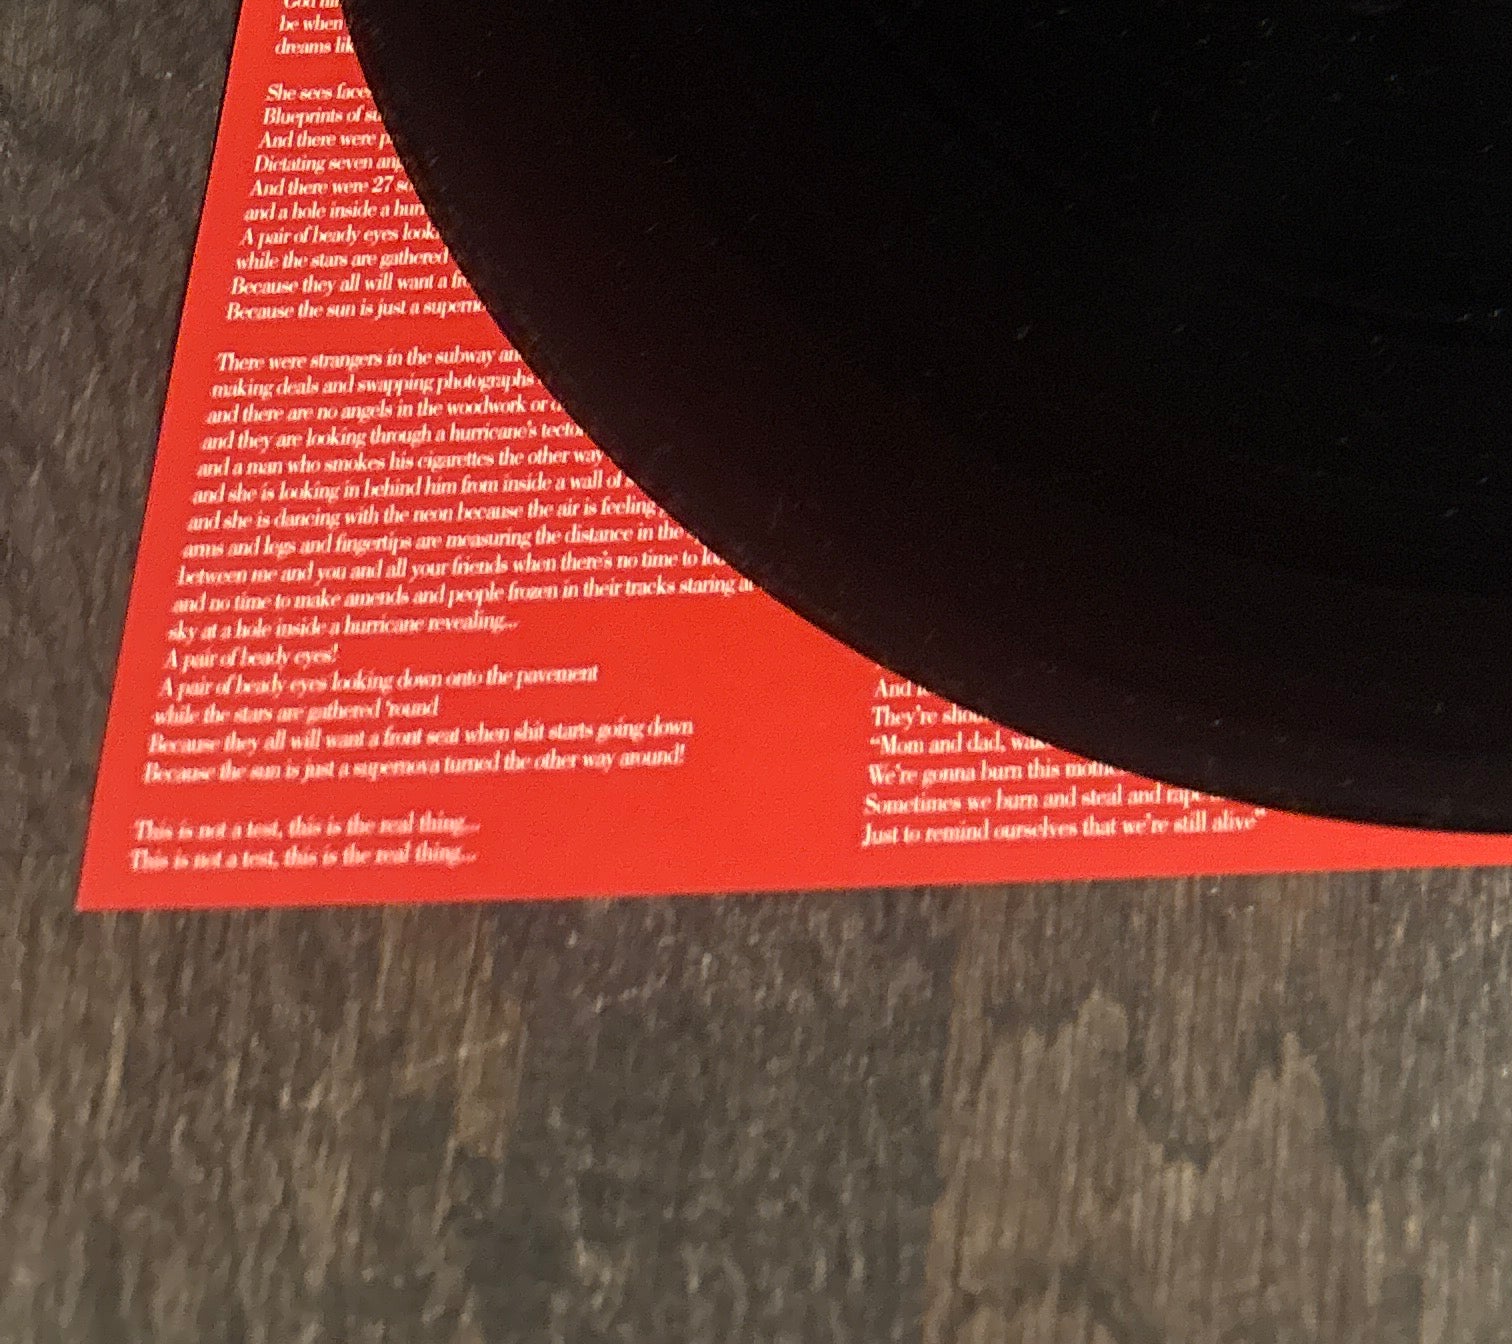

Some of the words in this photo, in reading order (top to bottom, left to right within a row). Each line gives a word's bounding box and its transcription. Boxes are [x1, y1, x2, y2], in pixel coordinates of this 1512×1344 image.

[278, 14, 299, 32] be
[302, 13, 343, 31] when
[274, 36, 330, 54] dreams
[265, 82, 297, 101] She
[298, 88, 332, 100] sees
[262, 106, 343, 128] Blueprints
[346, 104, 365, 122] of
[257, 129, 294, 148] And
[296, 129, 336, 148] there
[339, 133, 376, 146] were
[253, 154, 326, 174] Dictating
[327, 157, 373, 170] seven
[249, 177, 285, 196] And
[287, 177, 328, 195] there
[331, 181, 369, 194] were
[371, 174, 394, 193] 27
[243, 201, 276, 222] and
[277, 207, 288, 220] a
[291, 200, 326, 219] hole
[329, 199, 377, 219] inside
[379, 204, 390, 217] a
[239, 227, 253, 245] A
[257, 226, 292, 250] pair
[293, 224, 313, 243] of
[311, 223, 361, 246] beady
[363, 228, 399, 246] eyes
[236, 250, 279, 270] while
[281, 249, 308, 269] the
[309, 253, 348, 268] stars
[350, 253, 378, 267] are
[378, 246, 449, 269] gathered
[230, 275, 299, 295] Because
[302, 273, 336, 296] they
[338, 272, 361, 292] all
[364, 271, 393, 291] will
[397, 274, 434, 290] want
[437, 275, 447, 289] a
[215, 351, 265, 371] There
[268, 356, 307, 370] were
[309, 353, 383, 372] strangers
[385, 348, 403, 366] in
[406, 345, 432, 366] the
[434, 344, 495, 368] subway
[196, 455, 230, 477] and
[231, 462, 243, 476] a
[245, 460, 283, 475] man
[285, 453, 321, 473] who
[323, 451, 386, 472] smokes
[388, 449, 414, 470] his
[416, 450, 494, 473] cigarettes
[498, 445, 524, 466] the
[527, 444, 571, 465] other
[572, 448, 604, 467] way
[164, 647, 178, 669] A
[179, 647, 218, 674] pair
[219, 646, 241, 667] of
[238, 644, 291, 670] beady
[292, 642, 338, 669] eyes!
[873, 677, 912, 698] And
[871, 703, 938, 730] They're
[927, 731, 963, 754] and
[965, 729, 1006, 753] dad,
[868, 762, 918, 785] We're
[921, 766, 976, 787] gonna
[979, 759, 1023, 781] burn
[1027, 757, 1060, 779] this
[863, 791, 962, 814] Sometimes
[966, 796, 992, 811] we
[995, 788, 1038, 810] burn
[1042, 786, 1077, 808] and
[1081, 784, 1122, 806] steal
[1127, 782, 1163, 805] and
[861, 823, 900, 845] Just
[903, 825, 921, 843] to
[924, 819, 990, 842] remind
[993, 817, 1078, 840] ourselves
[1079, 815, 1118, 837] that
[1121, 813, 1169, 834] we're
[1173, 811, 1208, 833] still
